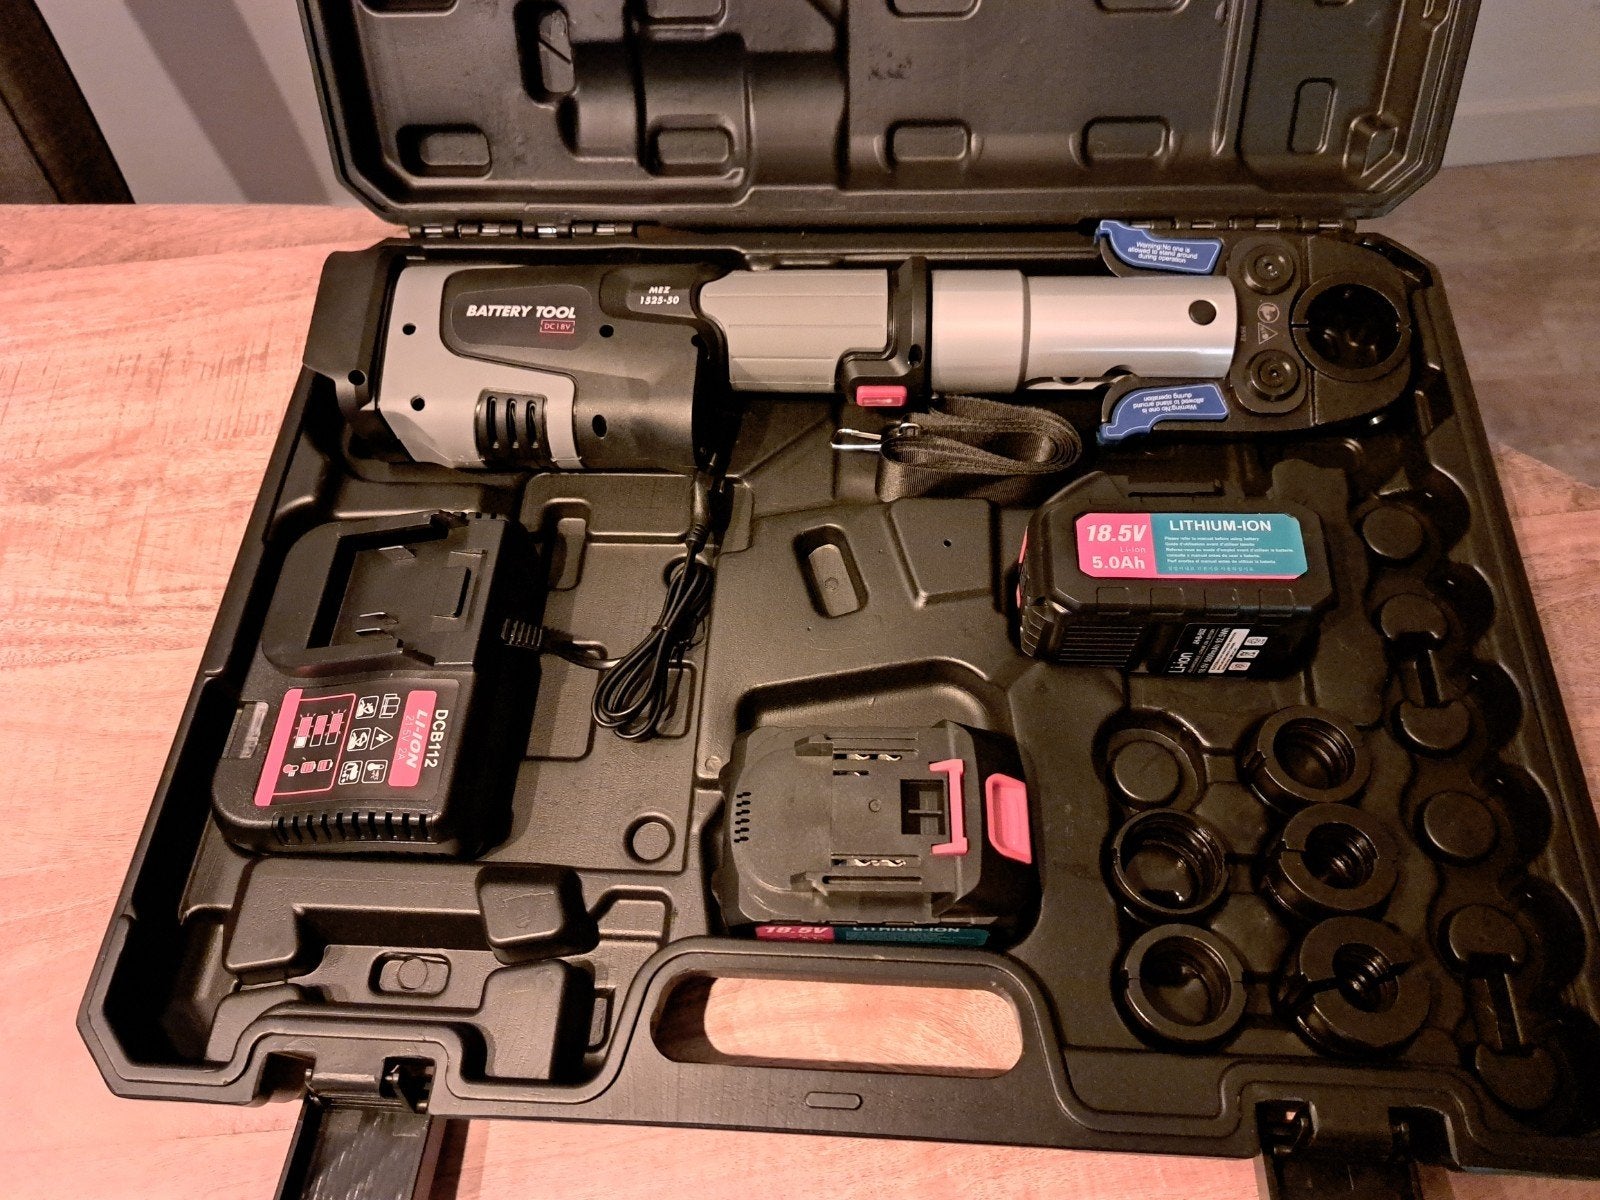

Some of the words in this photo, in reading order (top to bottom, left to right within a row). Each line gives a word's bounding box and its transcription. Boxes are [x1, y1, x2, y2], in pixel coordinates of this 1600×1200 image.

[1137, 253, 1158, 261] during
[1158, 255, 1187, 264] operation
[1176, 252, 1198, 260] around
[648, 286, 671, 294] MEZ
[640, 295, 680, 305] 1525-50
[466, 305, 532, 318] BATTERY
[535, 306, 576, 319] TOOL
[544, 322, 571, 331] DC18V
[1143, 393, 1172, 402] operation
[1172, 392, 1193, 400] during
[1169, 519, 1272, 532] LITHIUM-ION
[1086, 524, 1148, 542] 18.5V
[1092, 555, 1146, 569] 5.0Ah
[406, 709, 428, 769] LI-ION
[424, 709, 449, 768] DCB112
[763, 926, 829, 935] 18.5V
